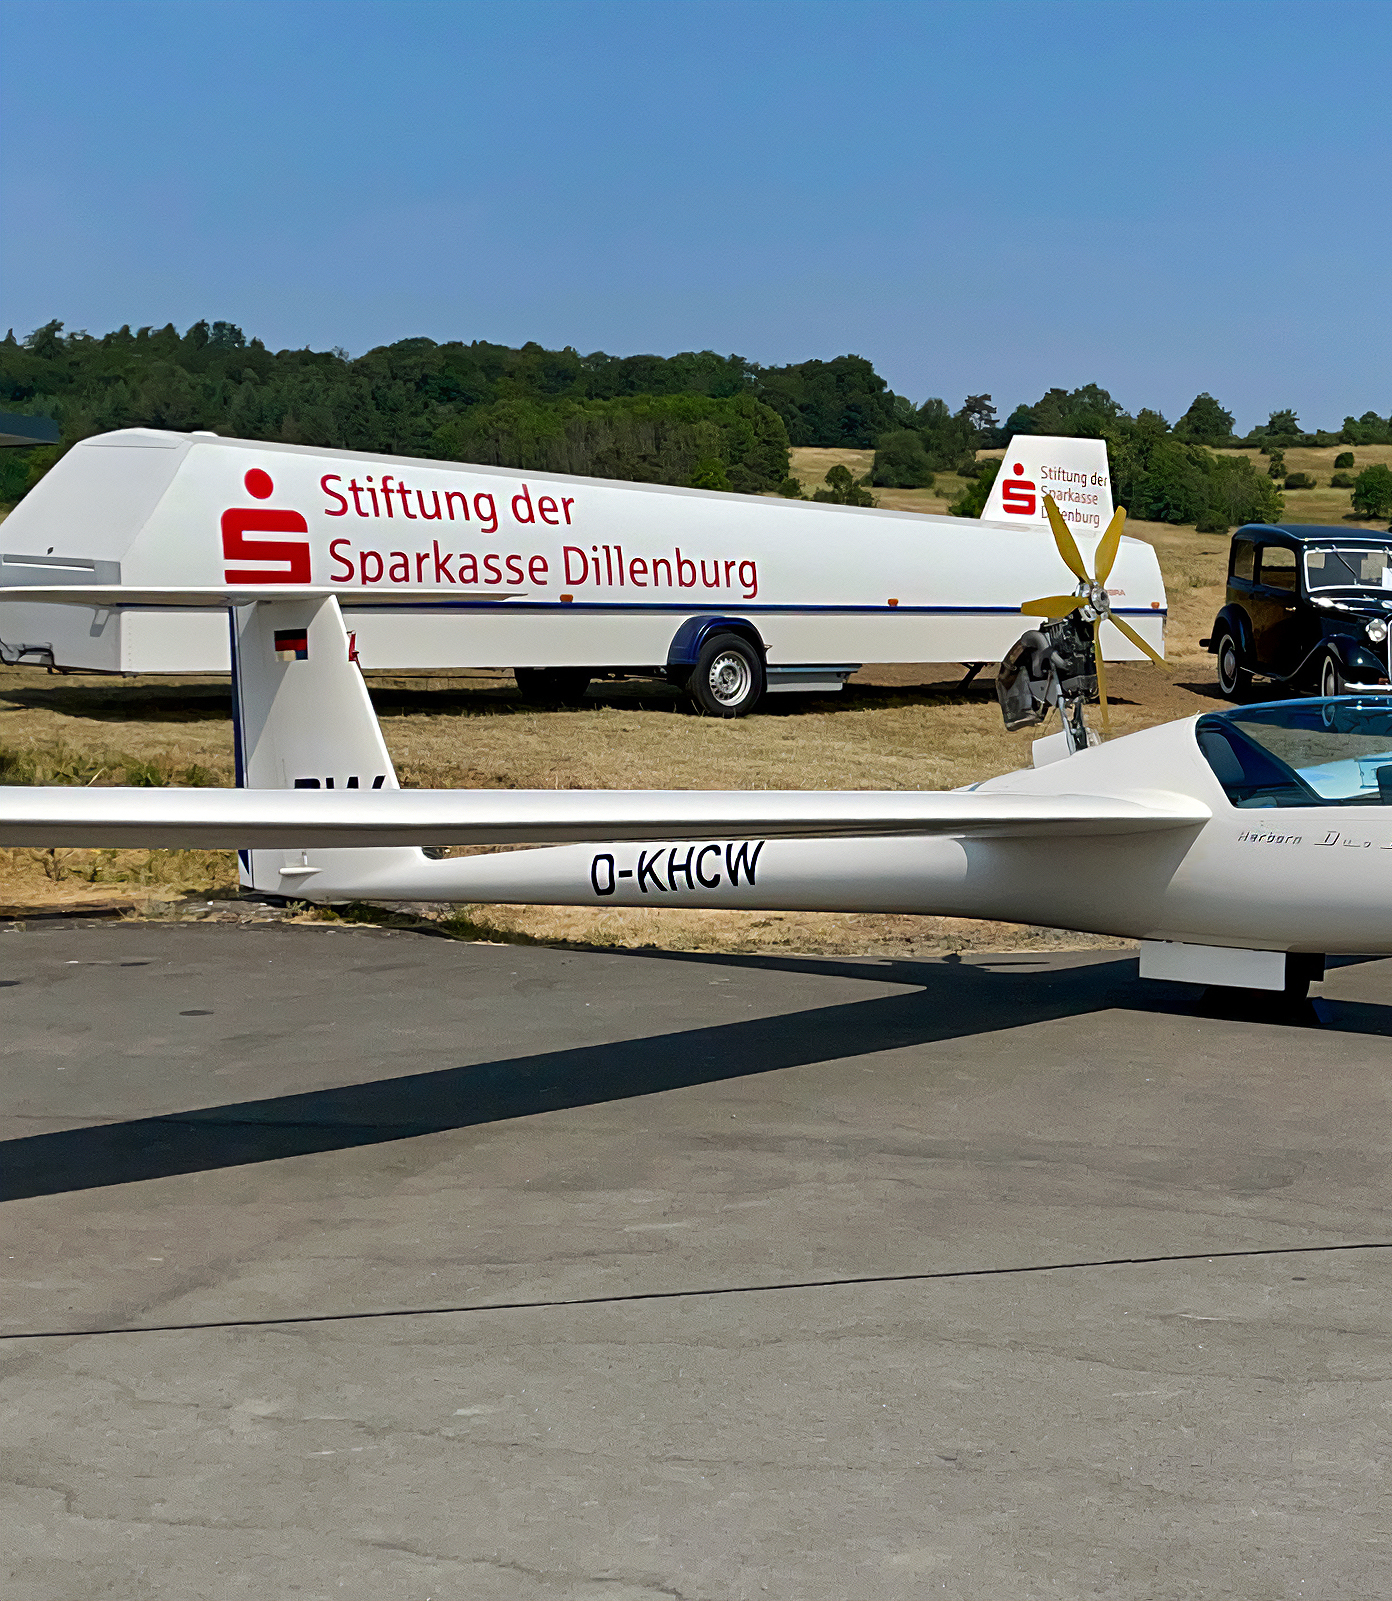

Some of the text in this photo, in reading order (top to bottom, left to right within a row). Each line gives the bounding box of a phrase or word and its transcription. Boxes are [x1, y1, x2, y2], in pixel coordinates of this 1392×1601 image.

[1040, 465, 1108, 488] Stiftung der
[320, 474, 575, 533] Stiftung der
[329, 538, 758, 599] Sparkasse Dillenburg
[1313, 830, 1372, 848] Duo
